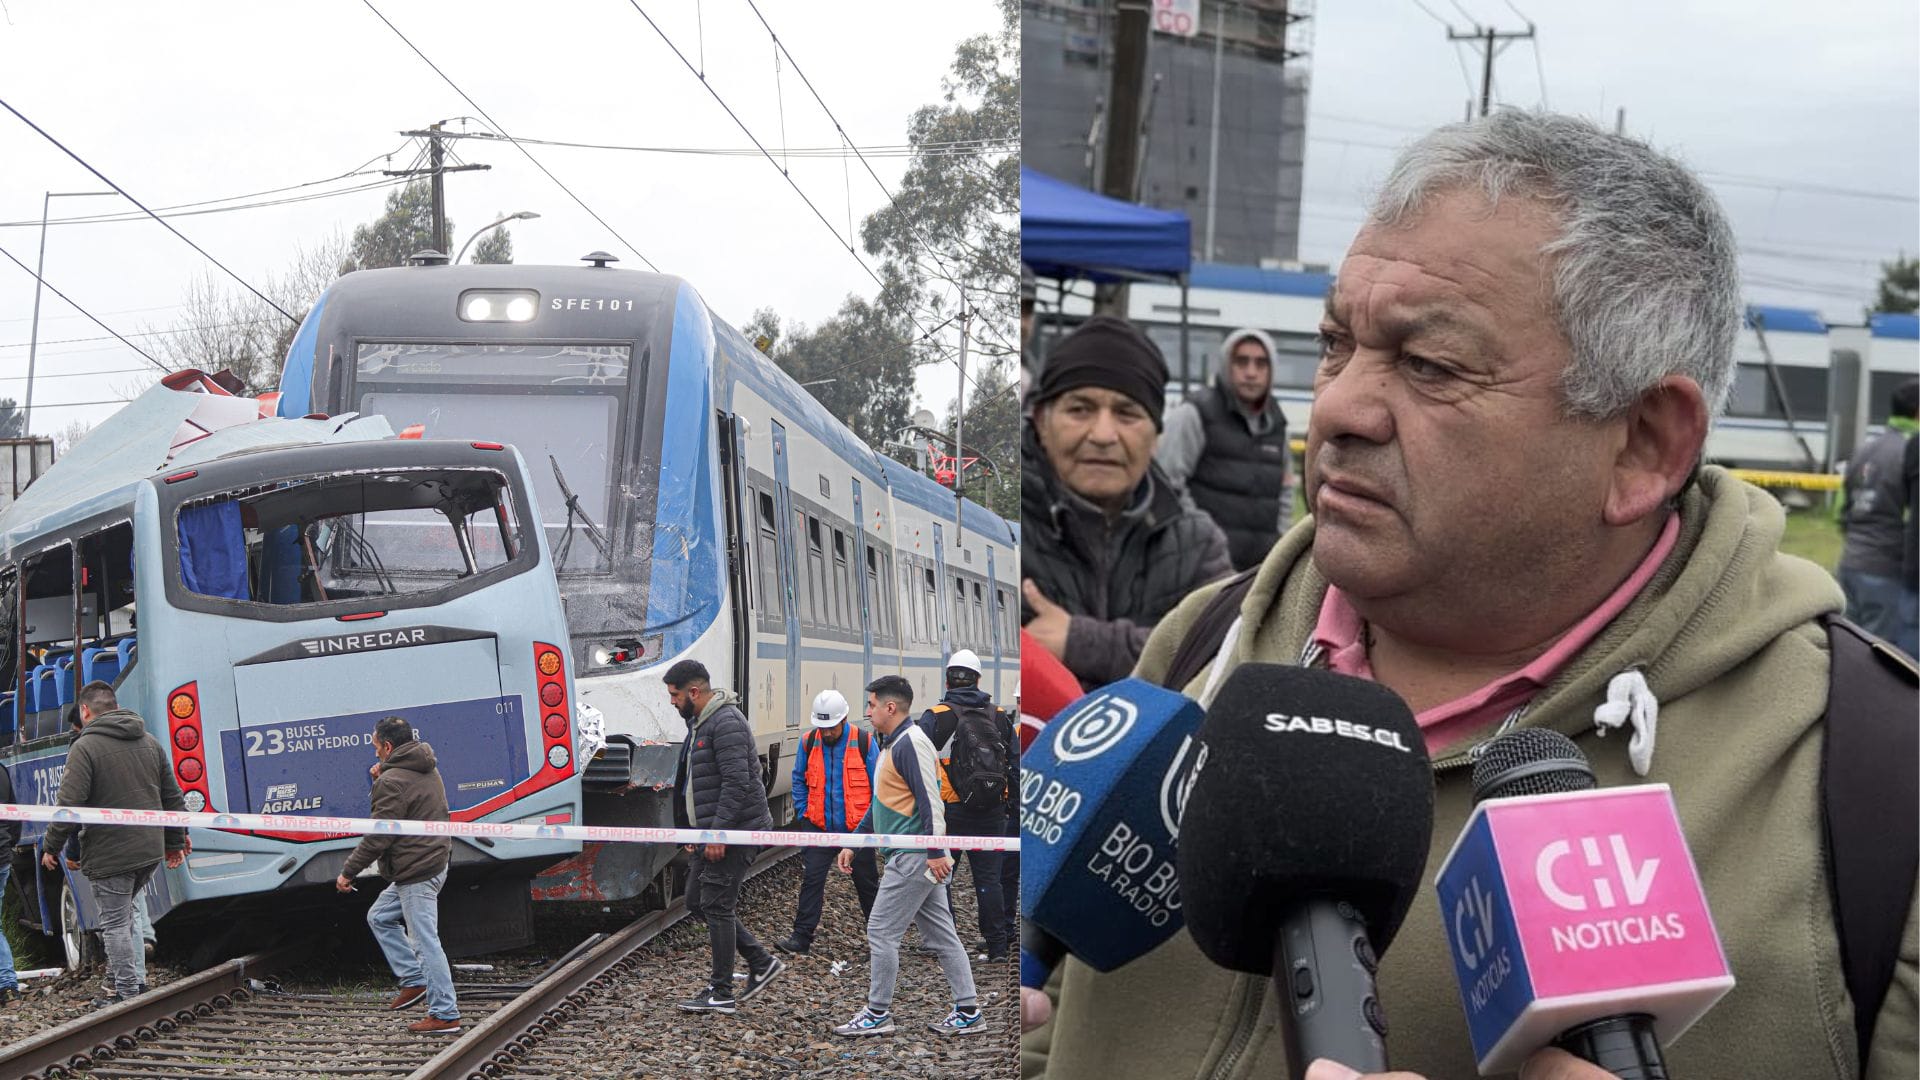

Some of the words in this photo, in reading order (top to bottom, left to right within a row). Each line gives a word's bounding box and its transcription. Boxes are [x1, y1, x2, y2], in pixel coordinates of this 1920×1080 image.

[551, 298, 633, 311] SFE101
[320, 629, 426, 653] INRECAR
[495, 701, 514, 715] 011
[245, 729, 285, 757] 23
[286, 724, 326, 740] BUSES
[287, 740, 314, 753] SAN
[317, 734, 360, 750] PEDRO
[261, 796, 322, 814] AGRALE
[1036, 780, 1082, 823] BIO
[1101, 821, 1154, 874] BIO
[1087, 852, 1114, 882] LA
[1111, 873, 1170, 927] RADIO
[1551, 913, 1686, 953] NOTICIAS
[1470, 947, 1512, 1014] NOTICIAS
